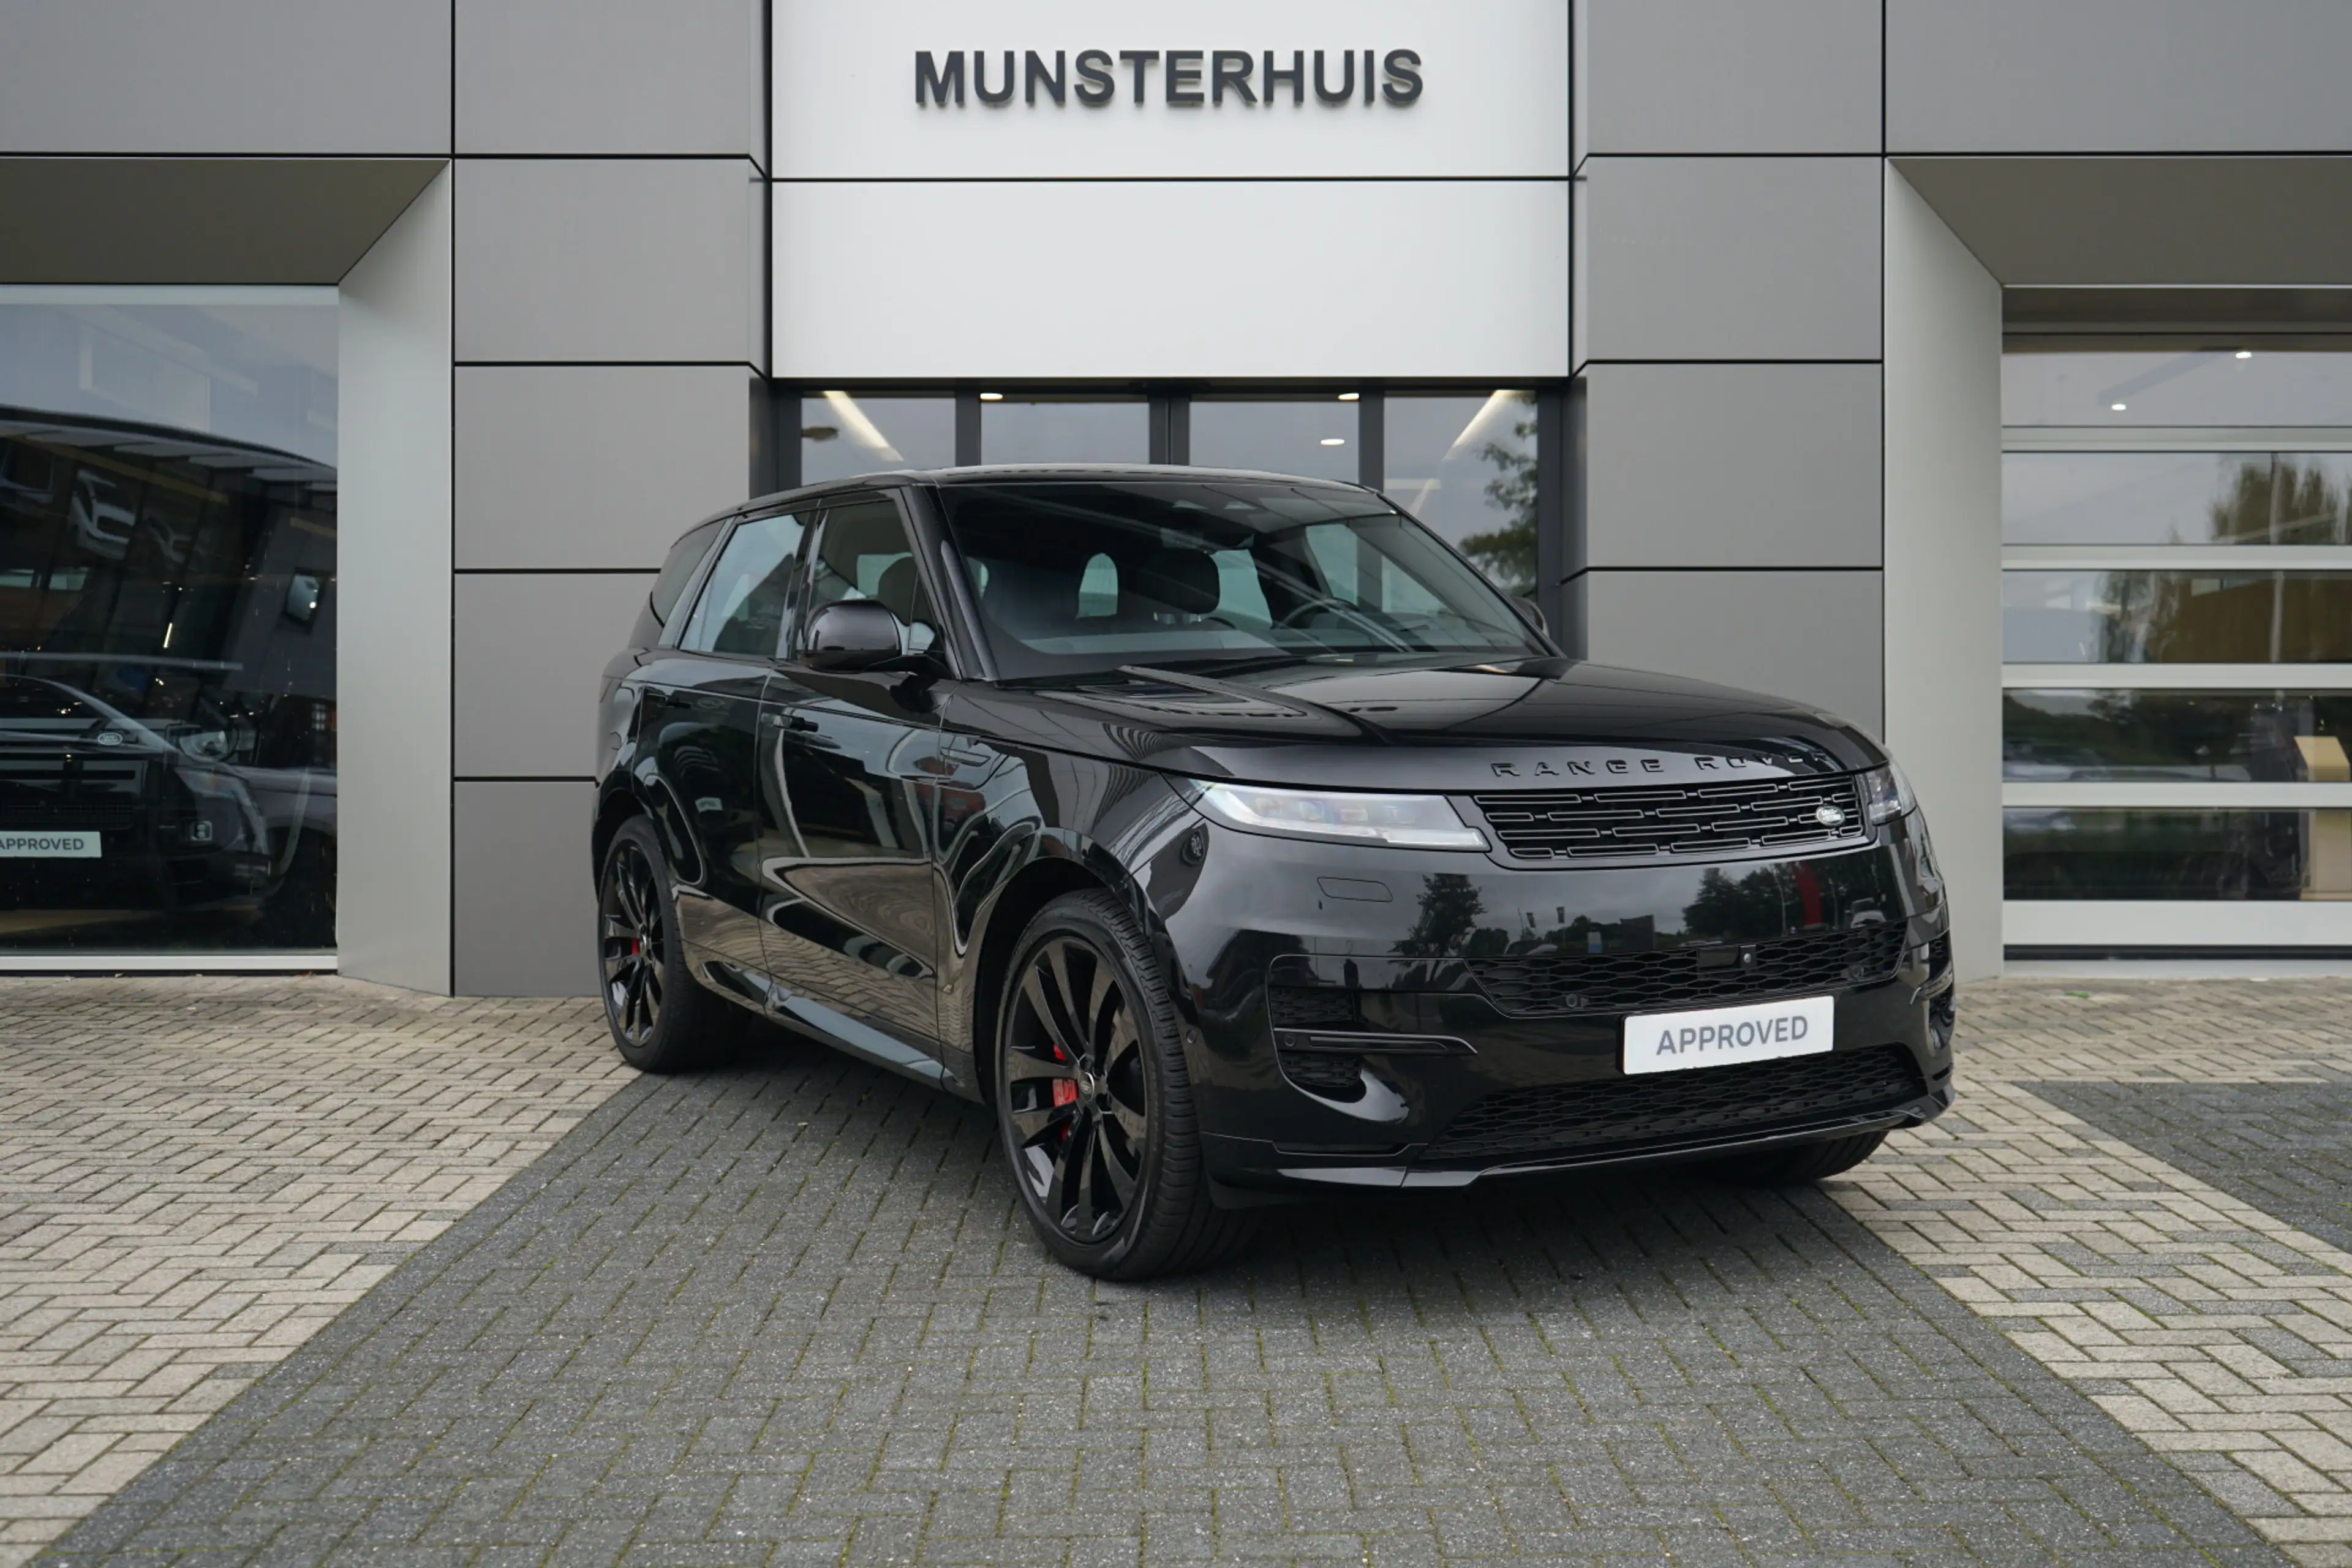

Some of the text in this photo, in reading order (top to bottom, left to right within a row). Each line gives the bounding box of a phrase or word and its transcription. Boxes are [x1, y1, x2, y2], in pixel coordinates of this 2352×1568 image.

[914, 49, 1423, 105] MUNSTERHUIS
[1490, 759, 1664, 777] RANGE
[1656, 1016, 1808, 1055] APPROVED
